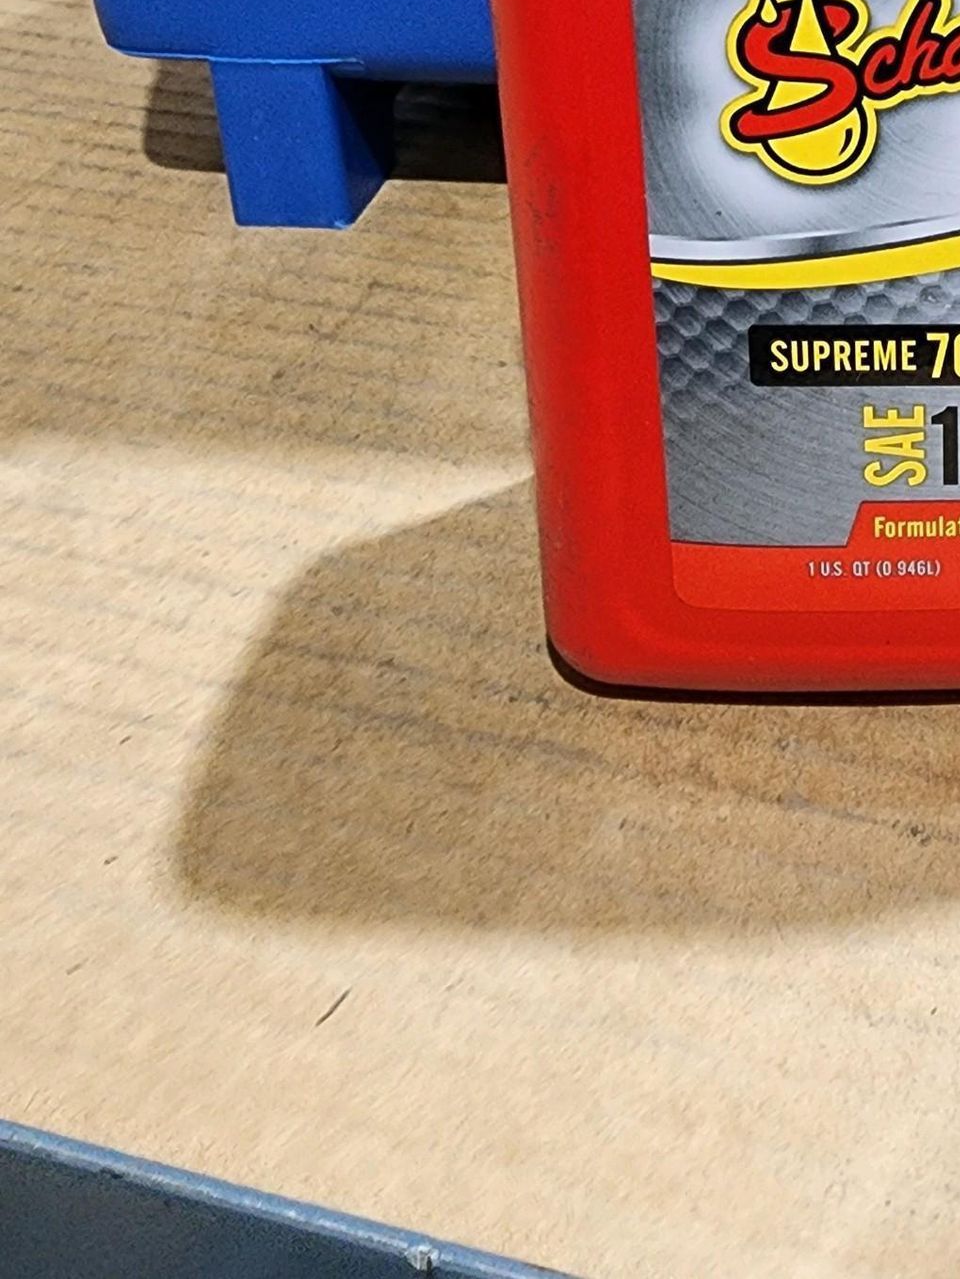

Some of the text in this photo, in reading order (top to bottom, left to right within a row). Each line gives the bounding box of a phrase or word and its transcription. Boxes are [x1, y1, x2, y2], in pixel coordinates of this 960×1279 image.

[770, 339, 917, 374] SUPREME
[862, 404, 928, 487] SAE
[807, 561, 815, 577] 1
[852, 561, 871, 577] QT
